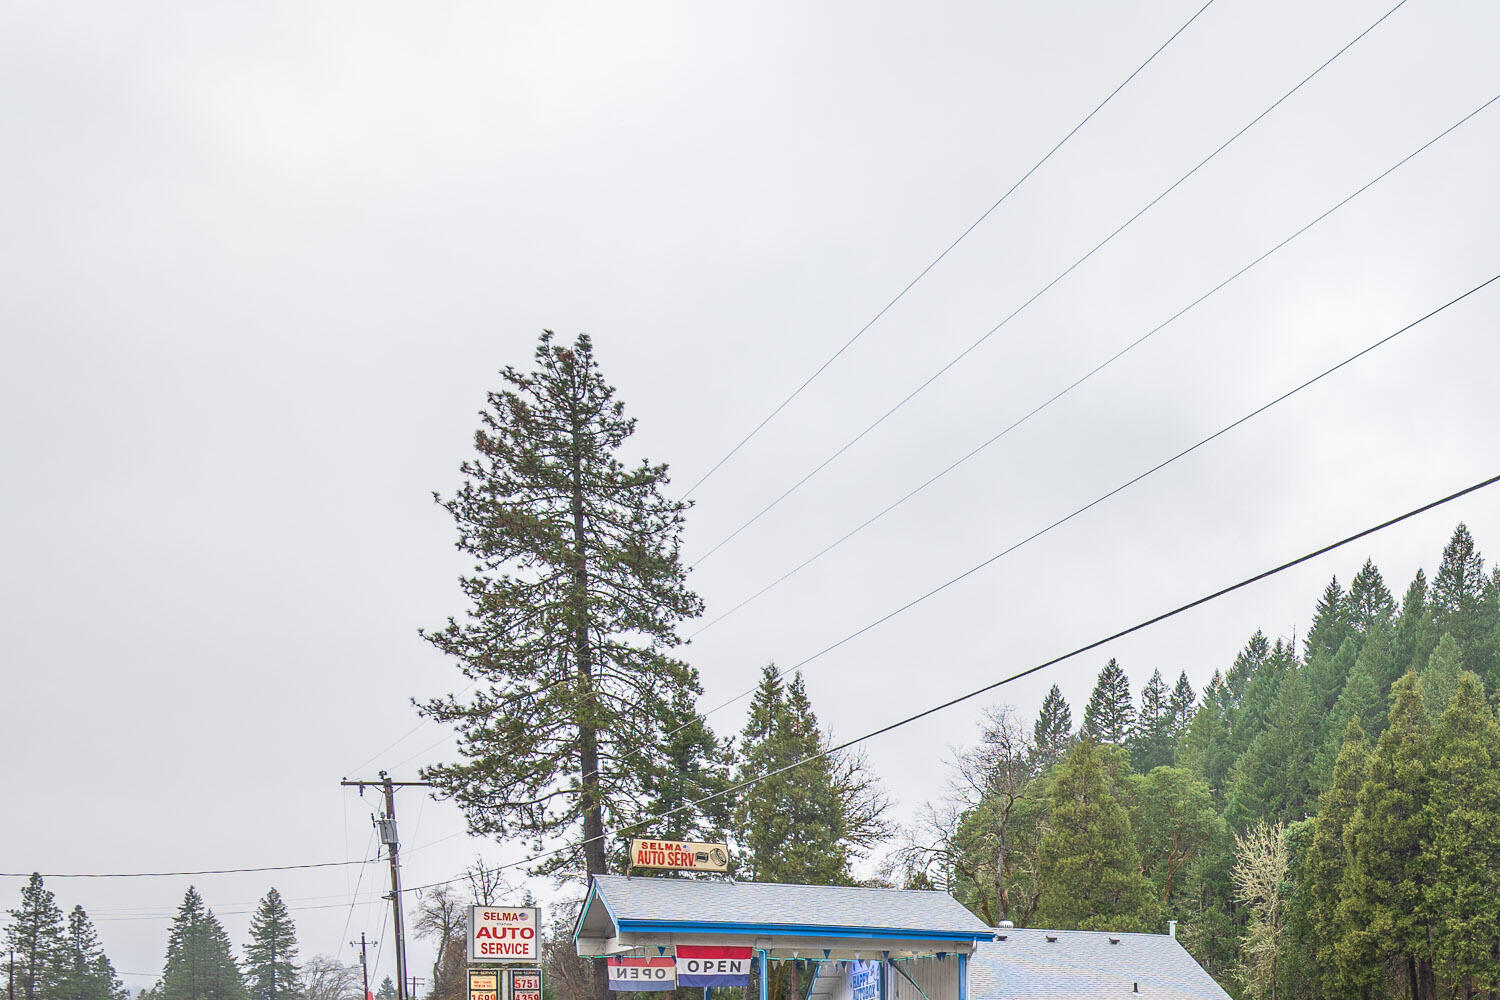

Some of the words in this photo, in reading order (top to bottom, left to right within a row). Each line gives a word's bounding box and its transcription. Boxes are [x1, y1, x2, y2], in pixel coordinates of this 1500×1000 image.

[641, 842, 682, 851] SELMA
[637, 850, 665, 865] AUTO
[667, 851, 696, 867] SERV.
[483, 912, 518, 921] SELMA
[476, 927, 534, 939] AUTO
[481, 942, 529, 955] SERVICE
[687, 960, 742, 973] OPEN
